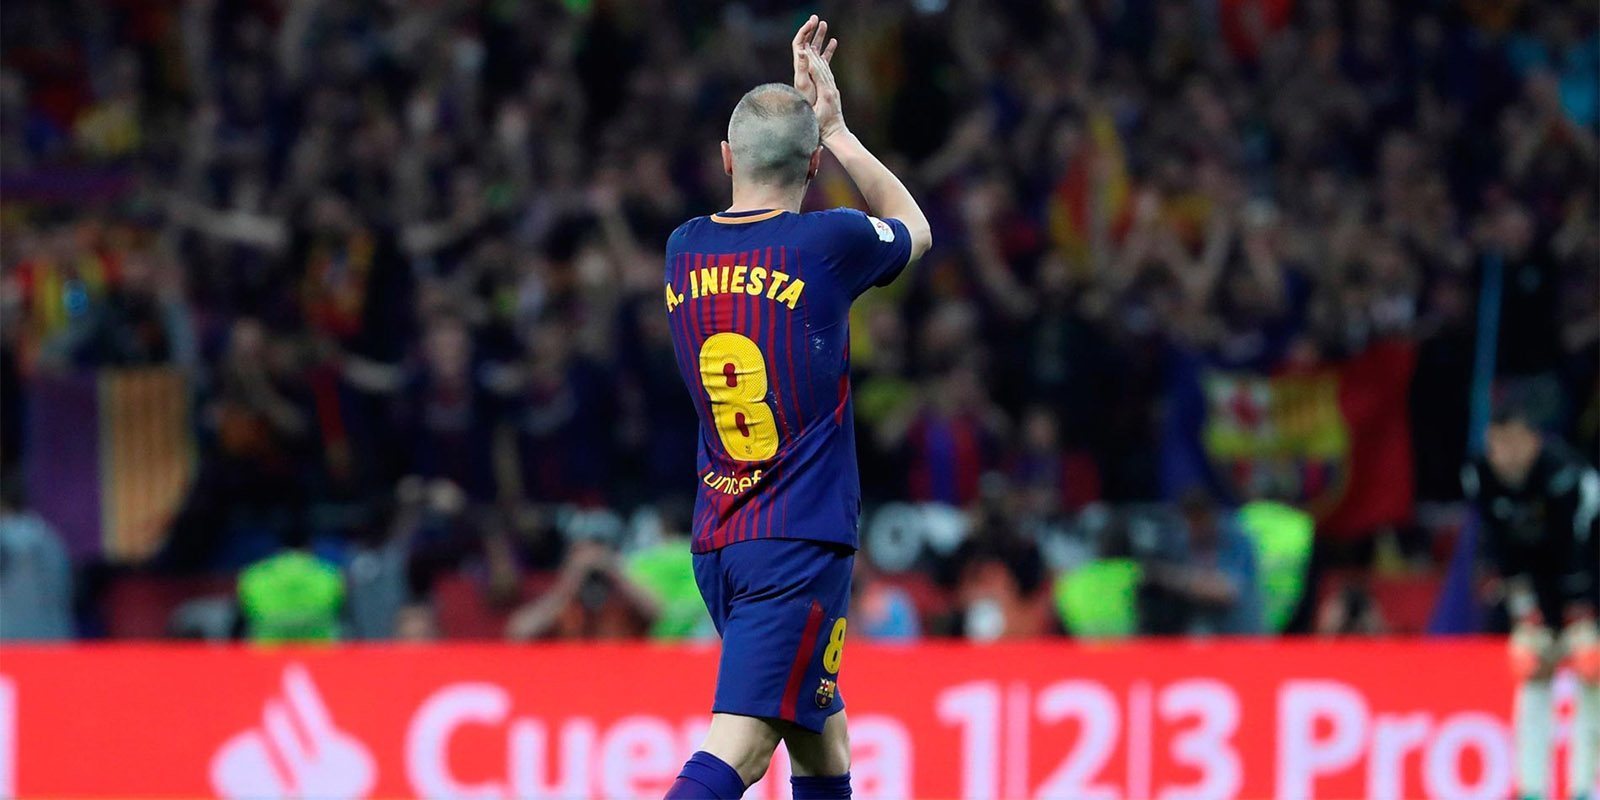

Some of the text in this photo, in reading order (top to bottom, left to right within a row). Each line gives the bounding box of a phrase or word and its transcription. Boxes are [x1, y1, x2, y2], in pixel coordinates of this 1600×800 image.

[666, 265, 805, 313] A. INIESTA
[699, 332, 780, 462] 8
[703, 469, 762, 495] unicef
[822, 617, 847, 675] 8
[405, 681, 913, 800] Cuea
